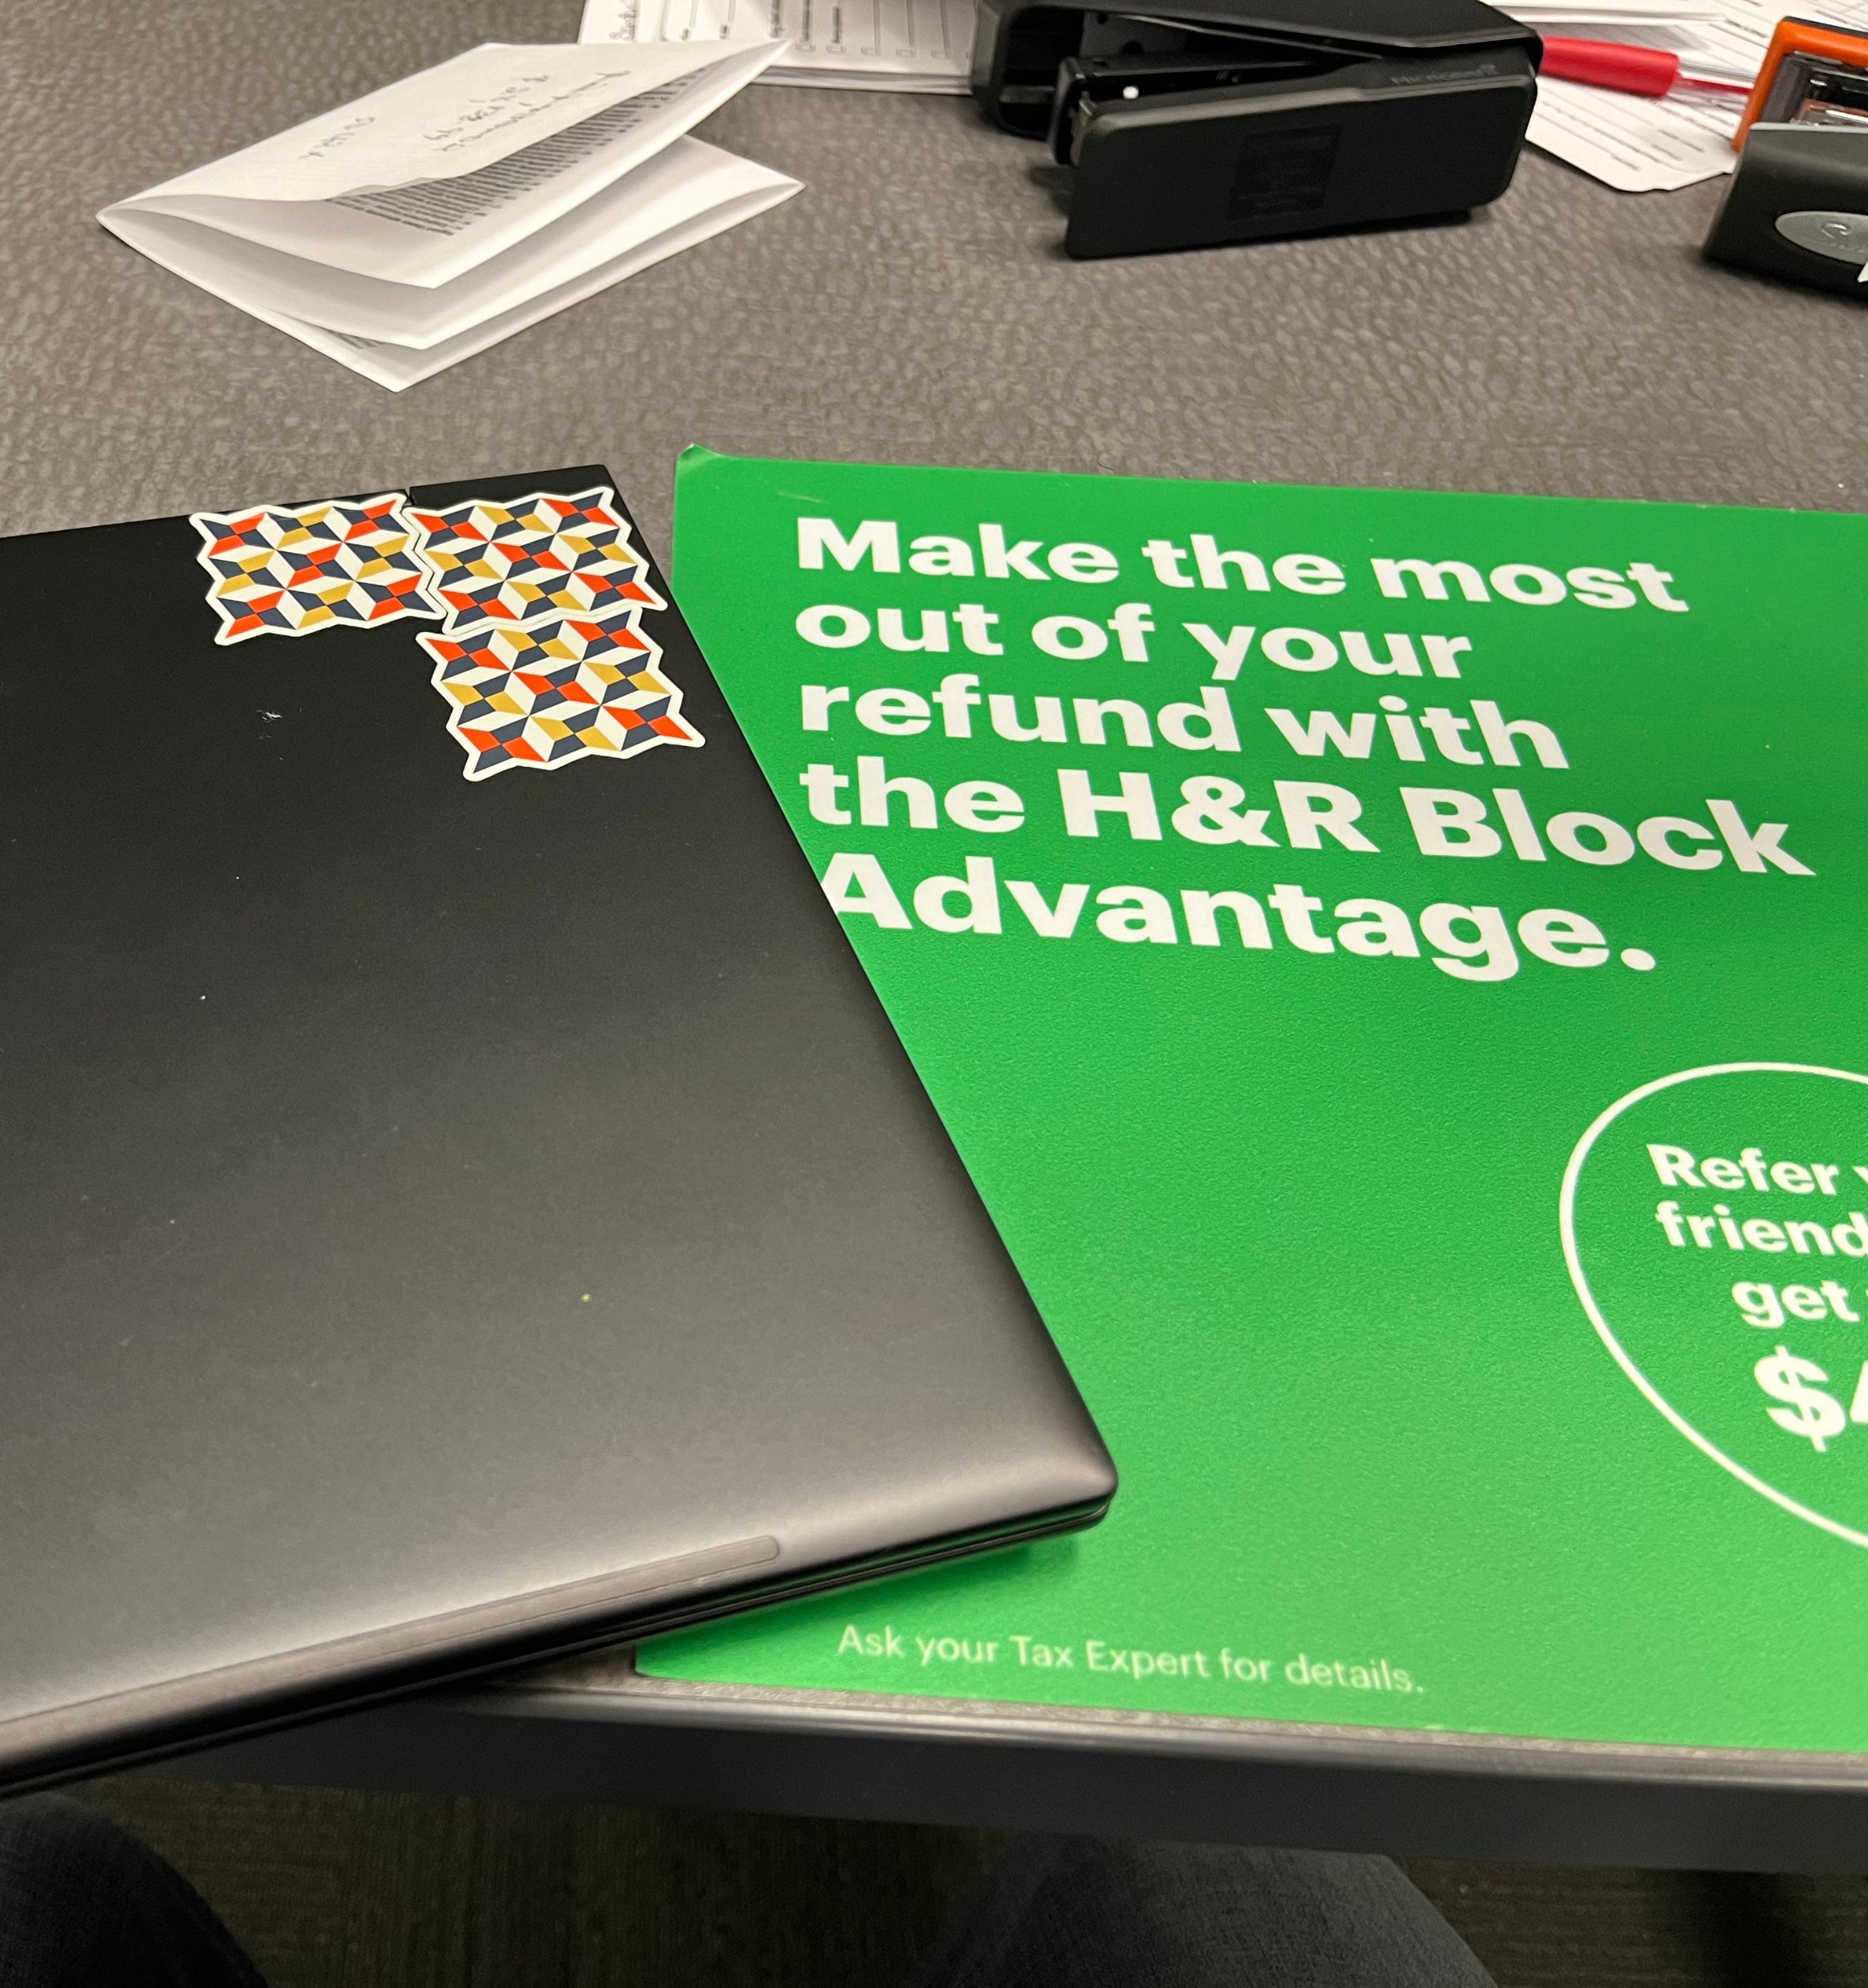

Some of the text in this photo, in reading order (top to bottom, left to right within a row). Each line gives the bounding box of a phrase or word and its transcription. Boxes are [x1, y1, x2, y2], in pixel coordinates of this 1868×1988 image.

[797, 517, 1689, 612] Make the most
[796, 602, 1473, 680] out of your
[801, 673, 1570, 769] refund with
[799, 756, 1816, 875] the H&R Block
[821, 852, 1656, 982] Advantage.
[1647, 1144, 1839, 1195] Refer
[1732, 1280, 1860, 1329] get
[836, 1625, 1426, 1694] Ask your Tax Expert for details.
